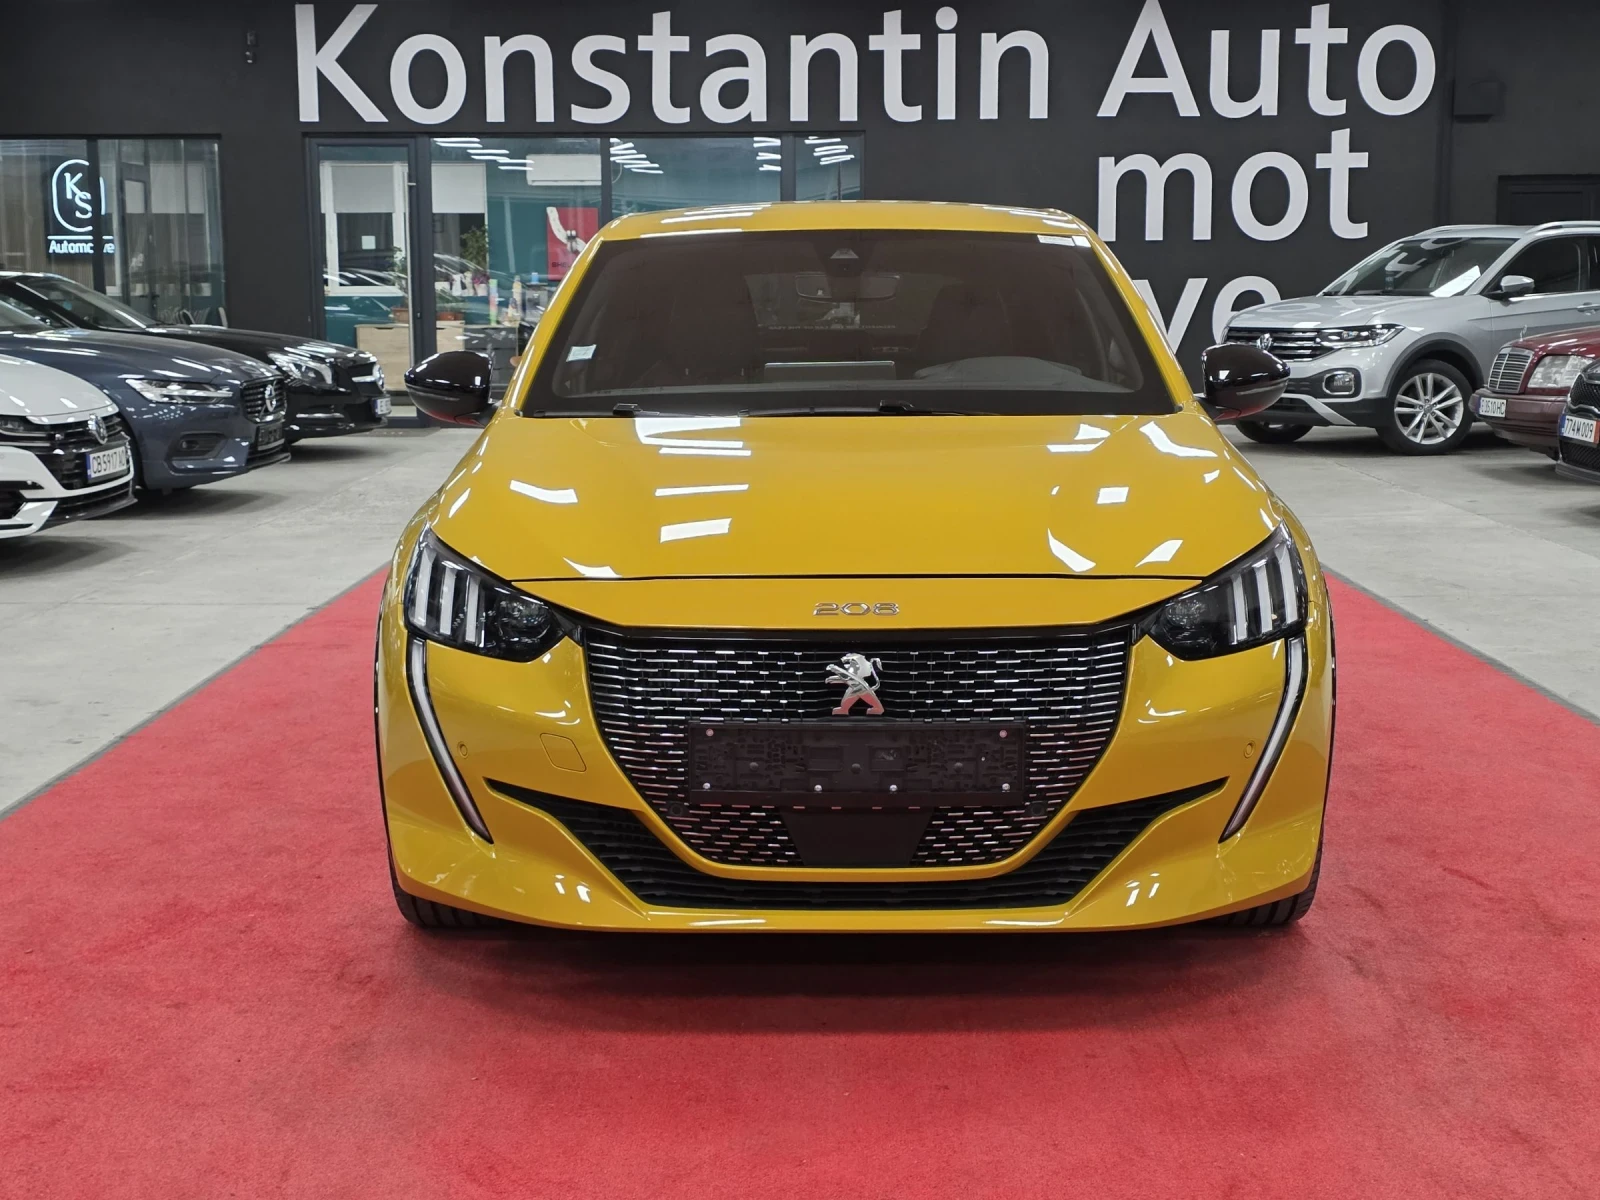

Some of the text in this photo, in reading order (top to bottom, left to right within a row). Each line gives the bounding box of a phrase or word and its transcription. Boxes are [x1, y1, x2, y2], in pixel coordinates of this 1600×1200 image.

[296, 0, 1436, 124] Konstantin Auto
[1098, 128, 1369, 242] mot
[813, 602, 900, 616] 208
